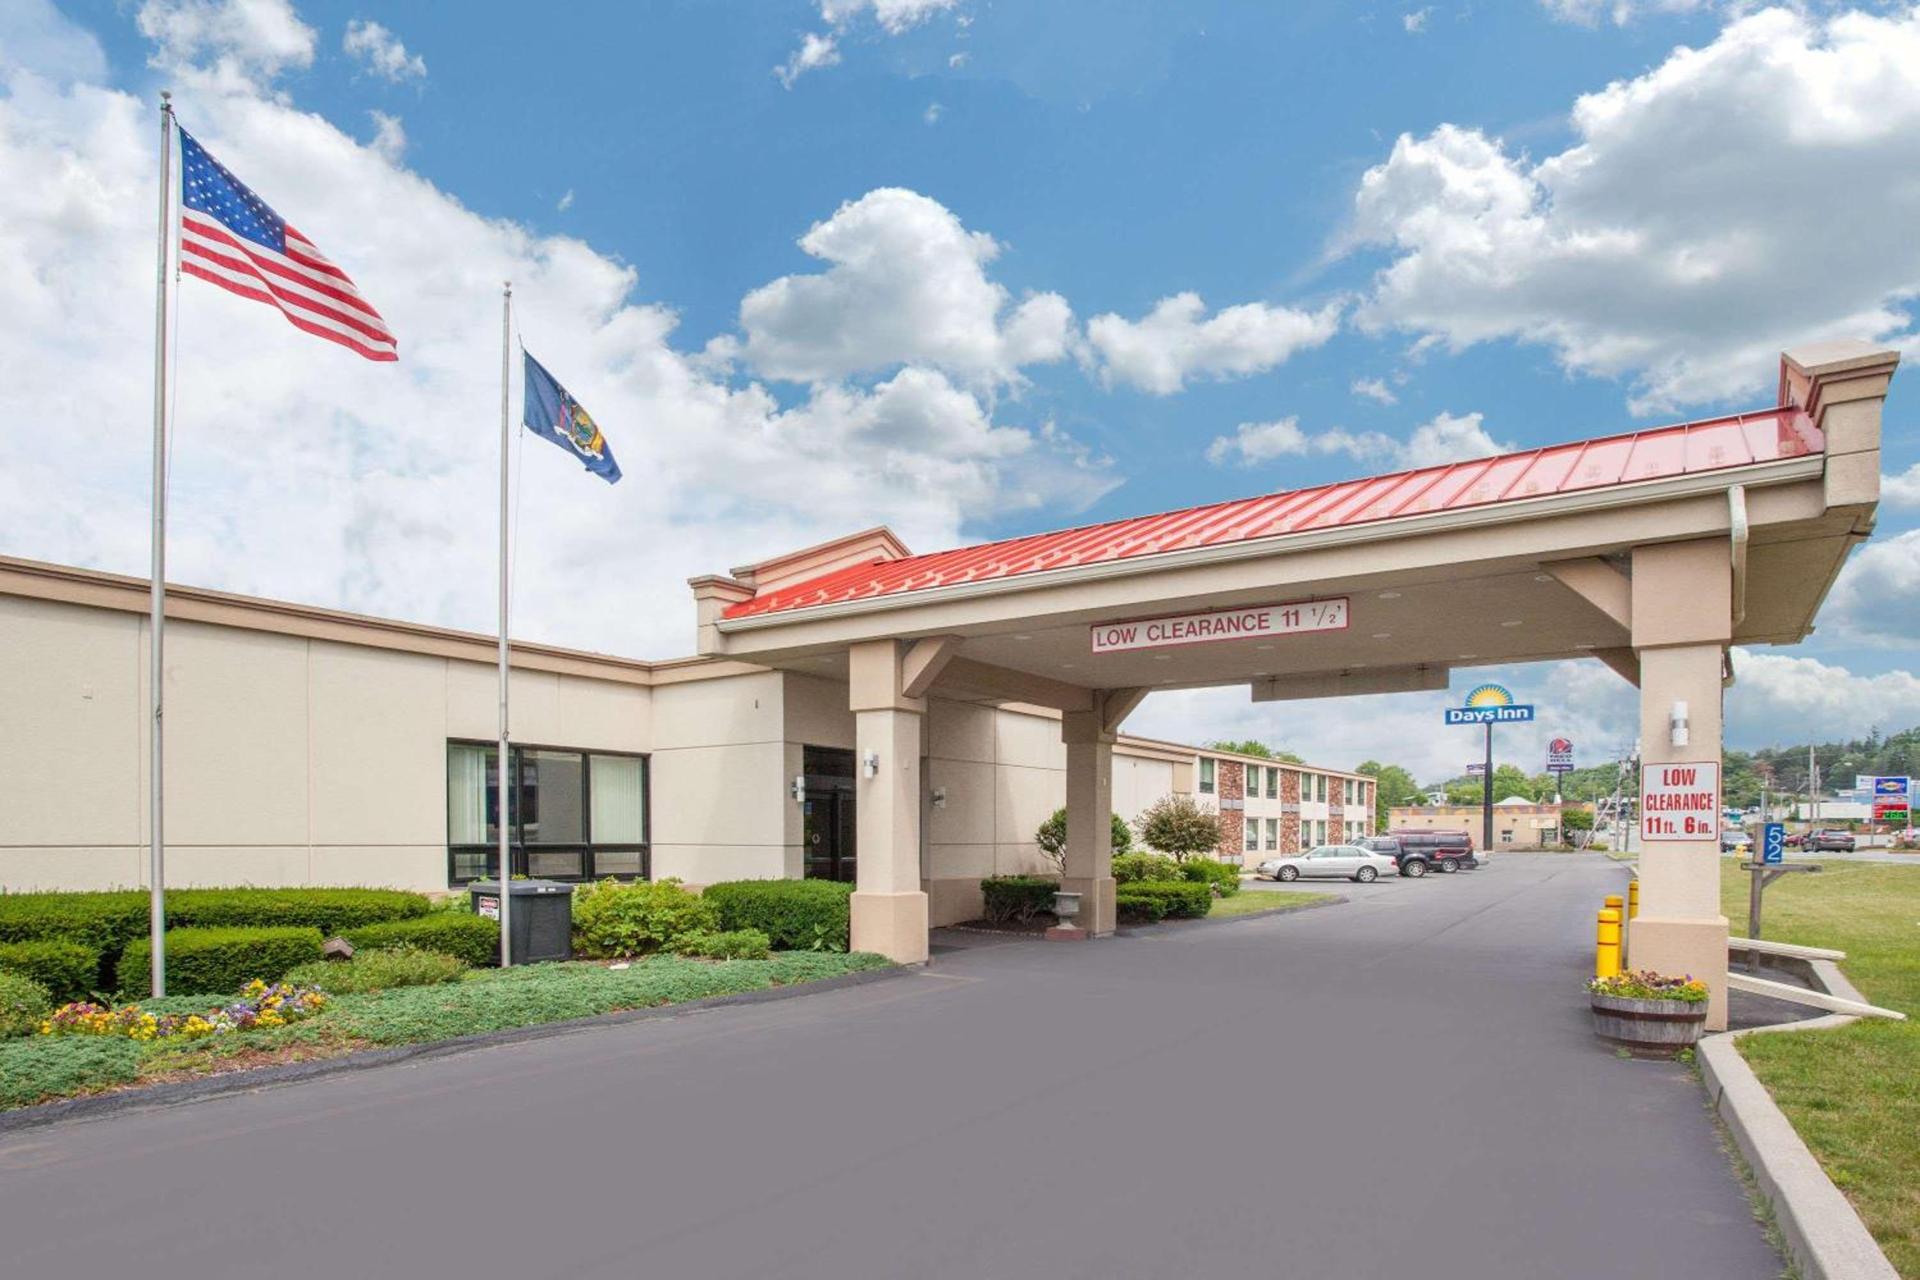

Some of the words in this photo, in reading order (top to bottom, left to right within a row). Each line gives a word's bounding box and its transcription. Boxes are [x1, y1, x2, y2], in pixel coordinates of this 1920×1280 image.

[1097, 628, 1137, 647] LOW
[1147, 613, 1270, 641] CLEARANCE
[1282, 609, 1300, 627] 11
[1450, 710, 1495, 722] Days
[1497, 707, 1529, 719] Inn
[1663, 768, 1696, 786] LOW
[1646, 793, 1713, 811] CLEARANCE
[1646, 816, 1661, 834] 11
[1664, 821, 1677, 834] ft.
[1684, 816, 1695, 834] 6
[1698, 820, 1712, 834] in.
